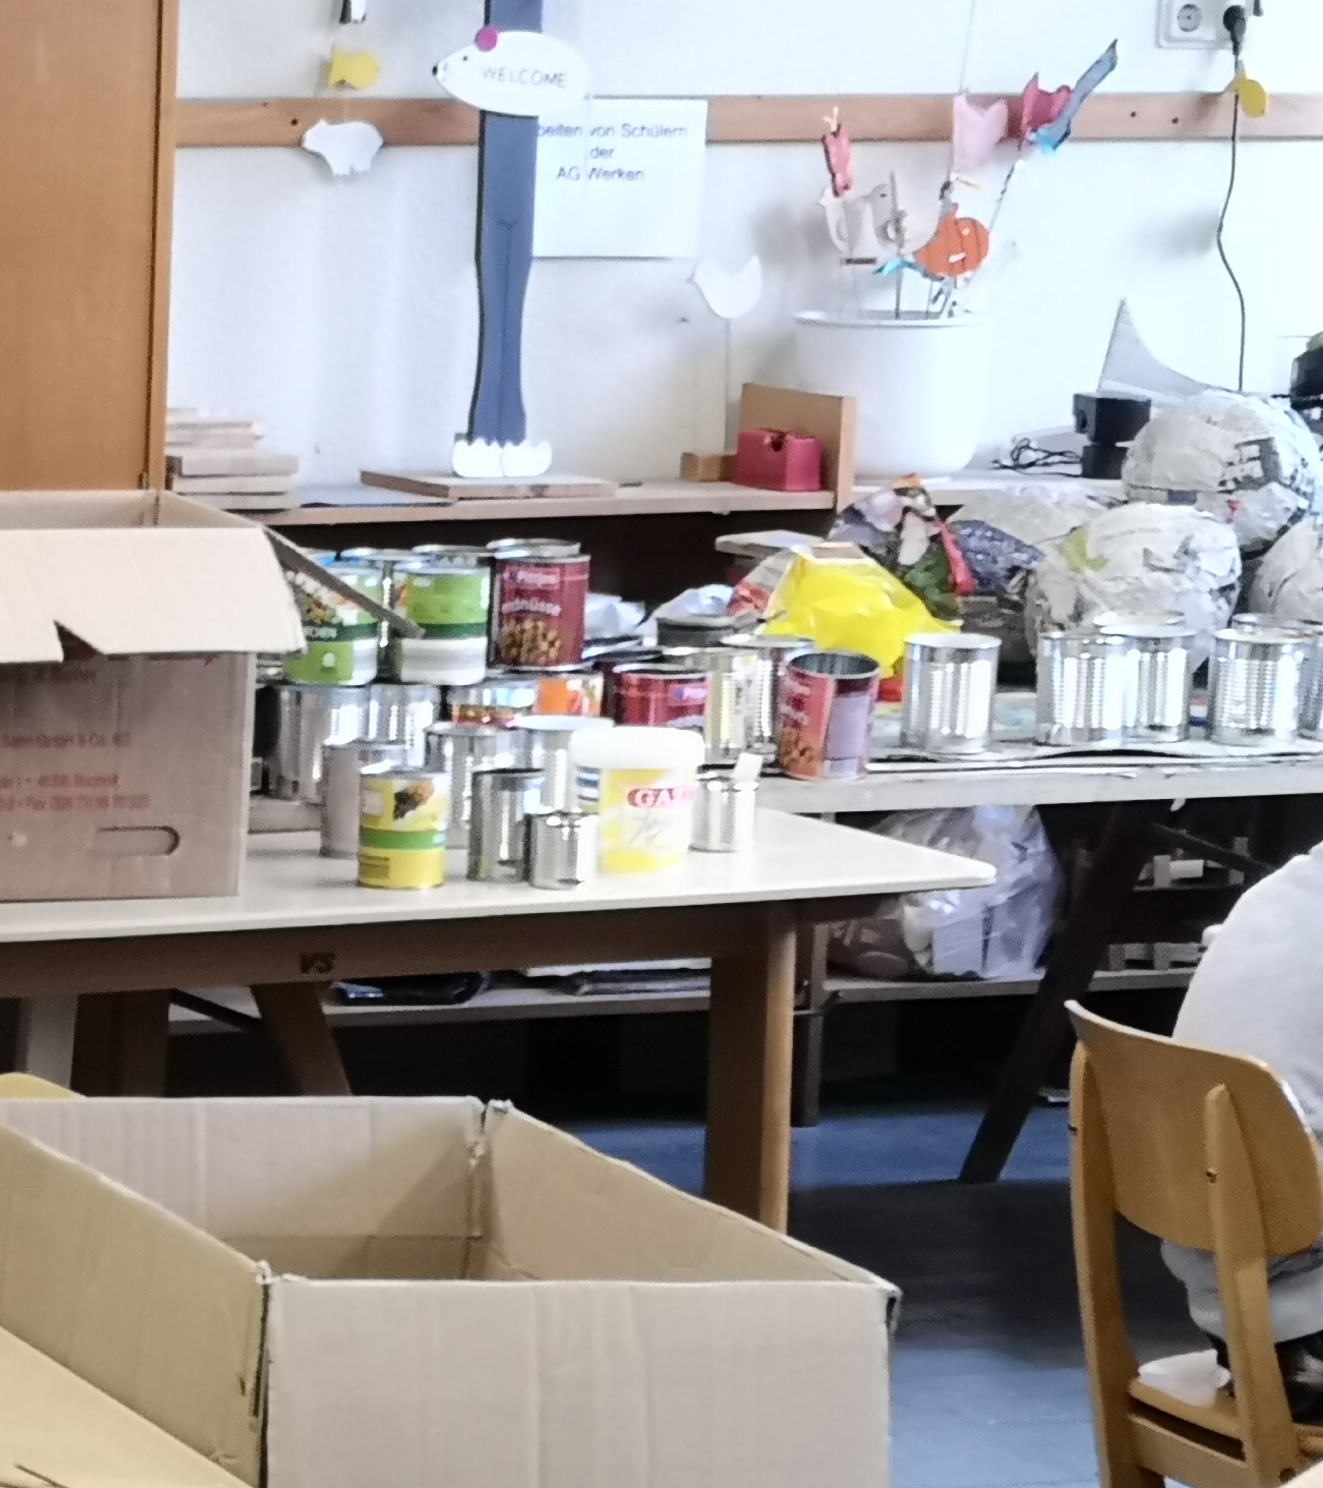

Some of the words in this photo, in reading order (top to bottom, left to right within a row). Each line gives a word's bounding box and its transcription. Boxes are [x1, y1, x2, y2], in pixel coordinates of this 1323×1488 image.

[481, 66, 568, 89] WELCOME
[537, 122, 583, 138] beiten
[590, 125, 615, 138] von
[620, 122, 688, 138] Schülern
[589, 145, 615, 159] der
[556, 166, 581, 181] AG
[587, 165, 645, 181] Werken
